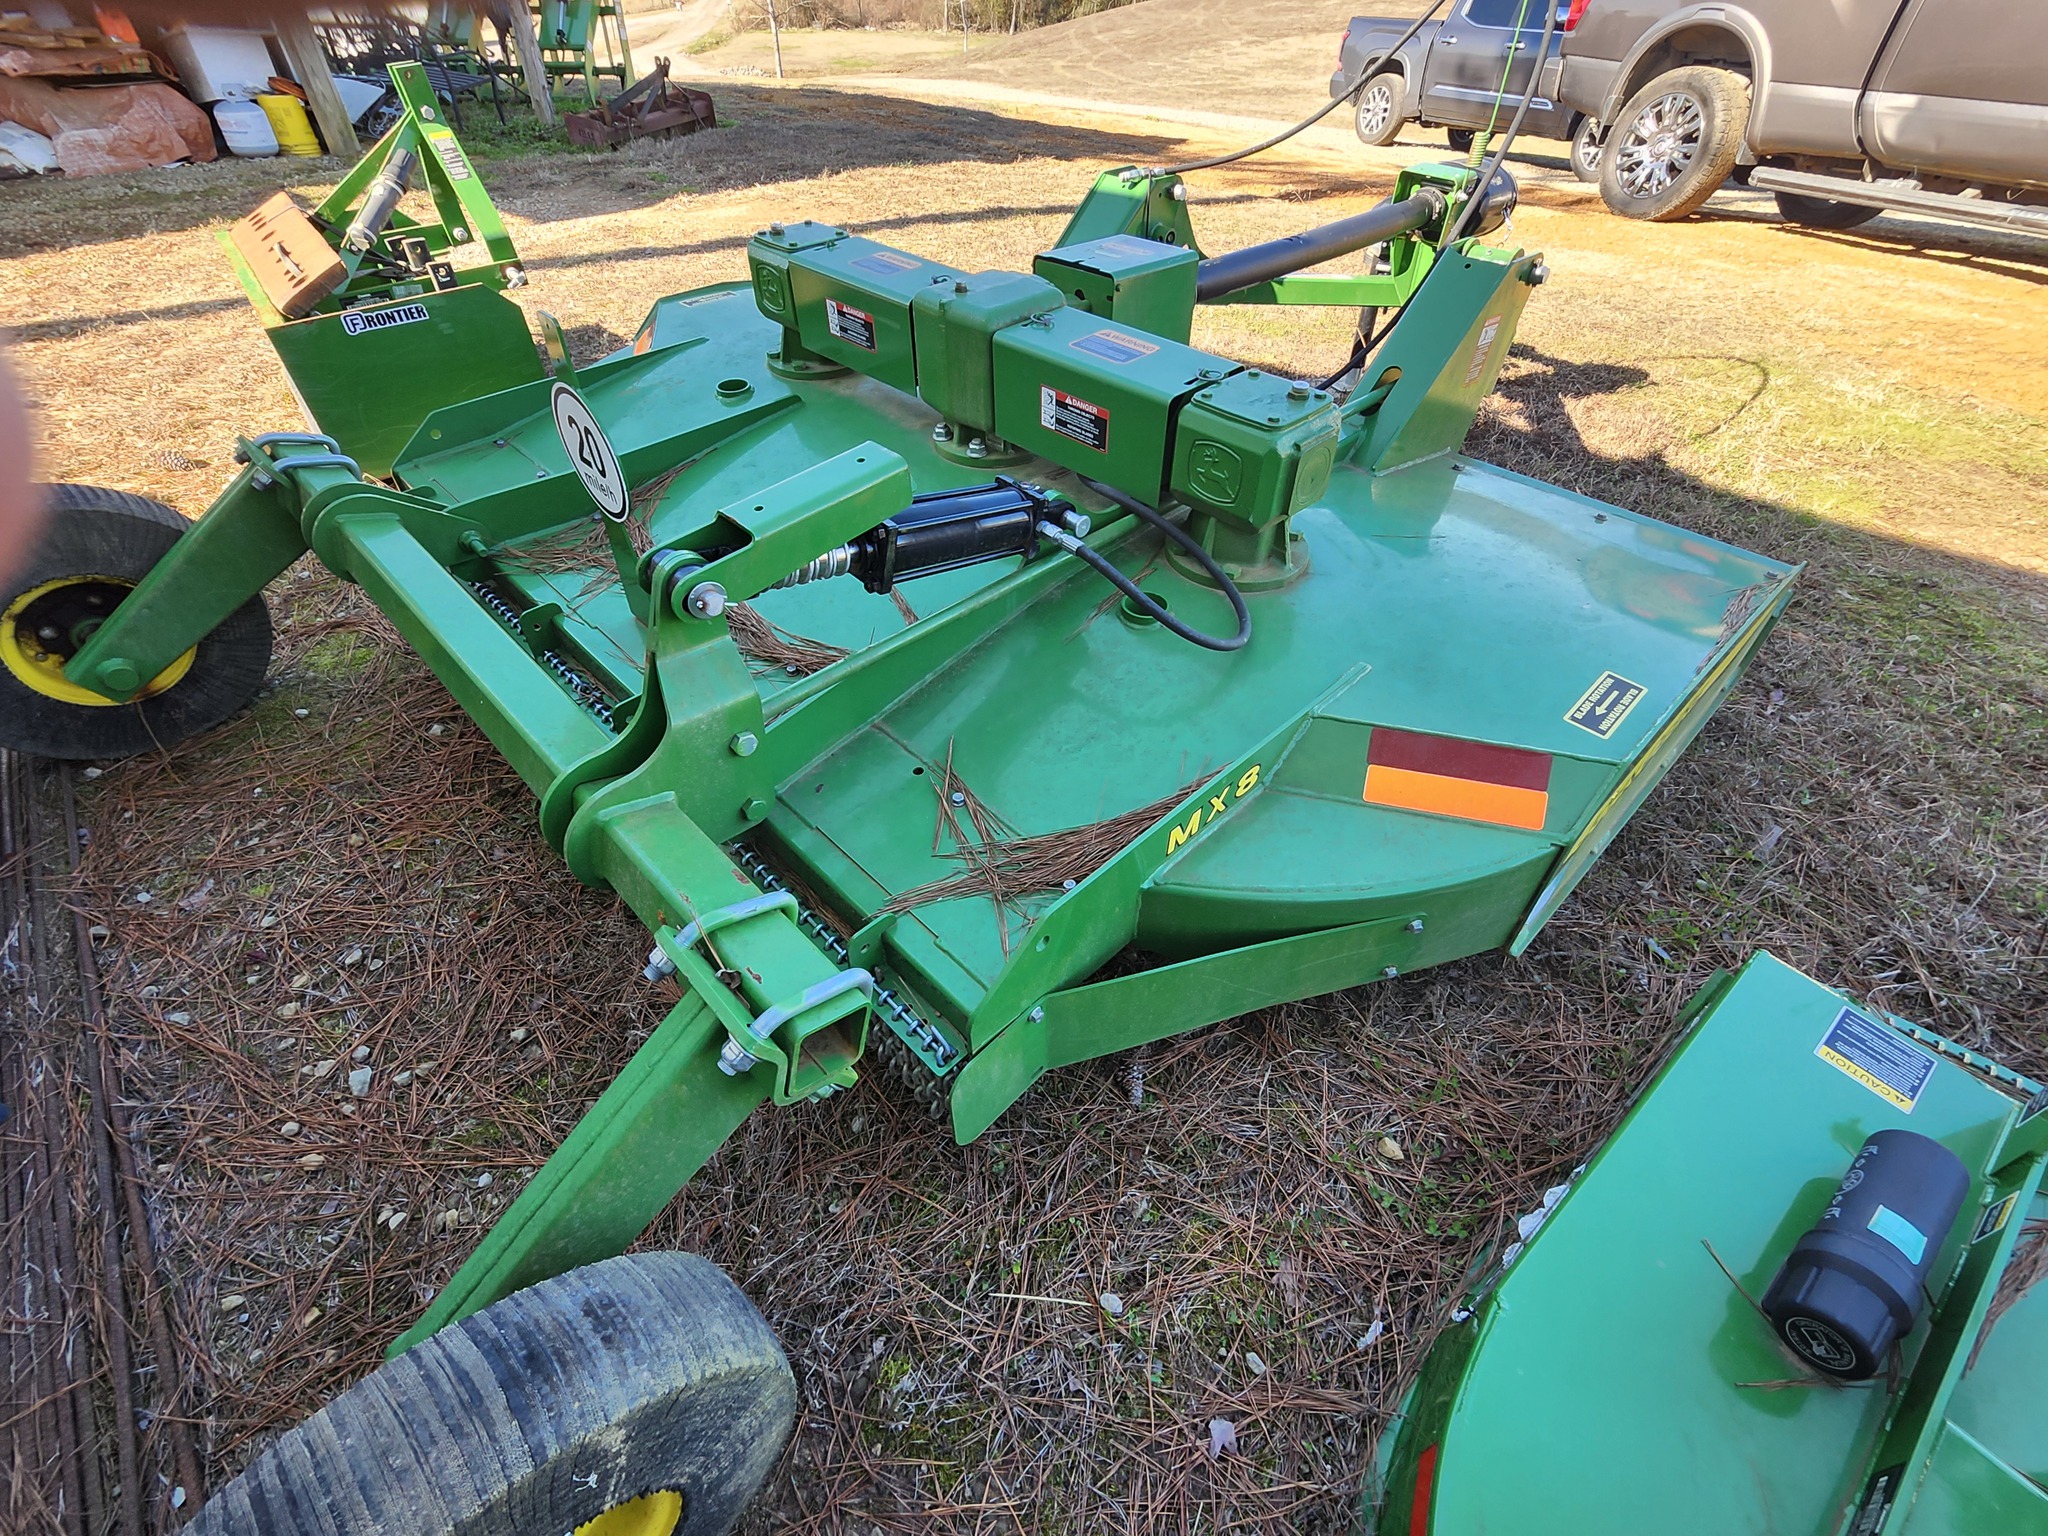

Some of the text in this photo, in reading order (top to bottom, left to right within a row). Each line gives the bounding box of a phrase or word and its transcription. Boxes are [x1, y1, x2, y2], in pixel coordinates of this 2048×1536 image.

[342, 305, 428, 334] FRONTIER
[1112, 334, 1156, 352] WARNING
[1072, 398, 1098, 415] DANGER
[567, 414, 607, 479] 20
[584, 471, 618, 506] mile/h
[1573, 677, 1615, 720] BLADE ROTATION
[1598, 688, 1639, 731] BLADE ROTATION
[1825, 1050, 1892, 1097] CAUTION
